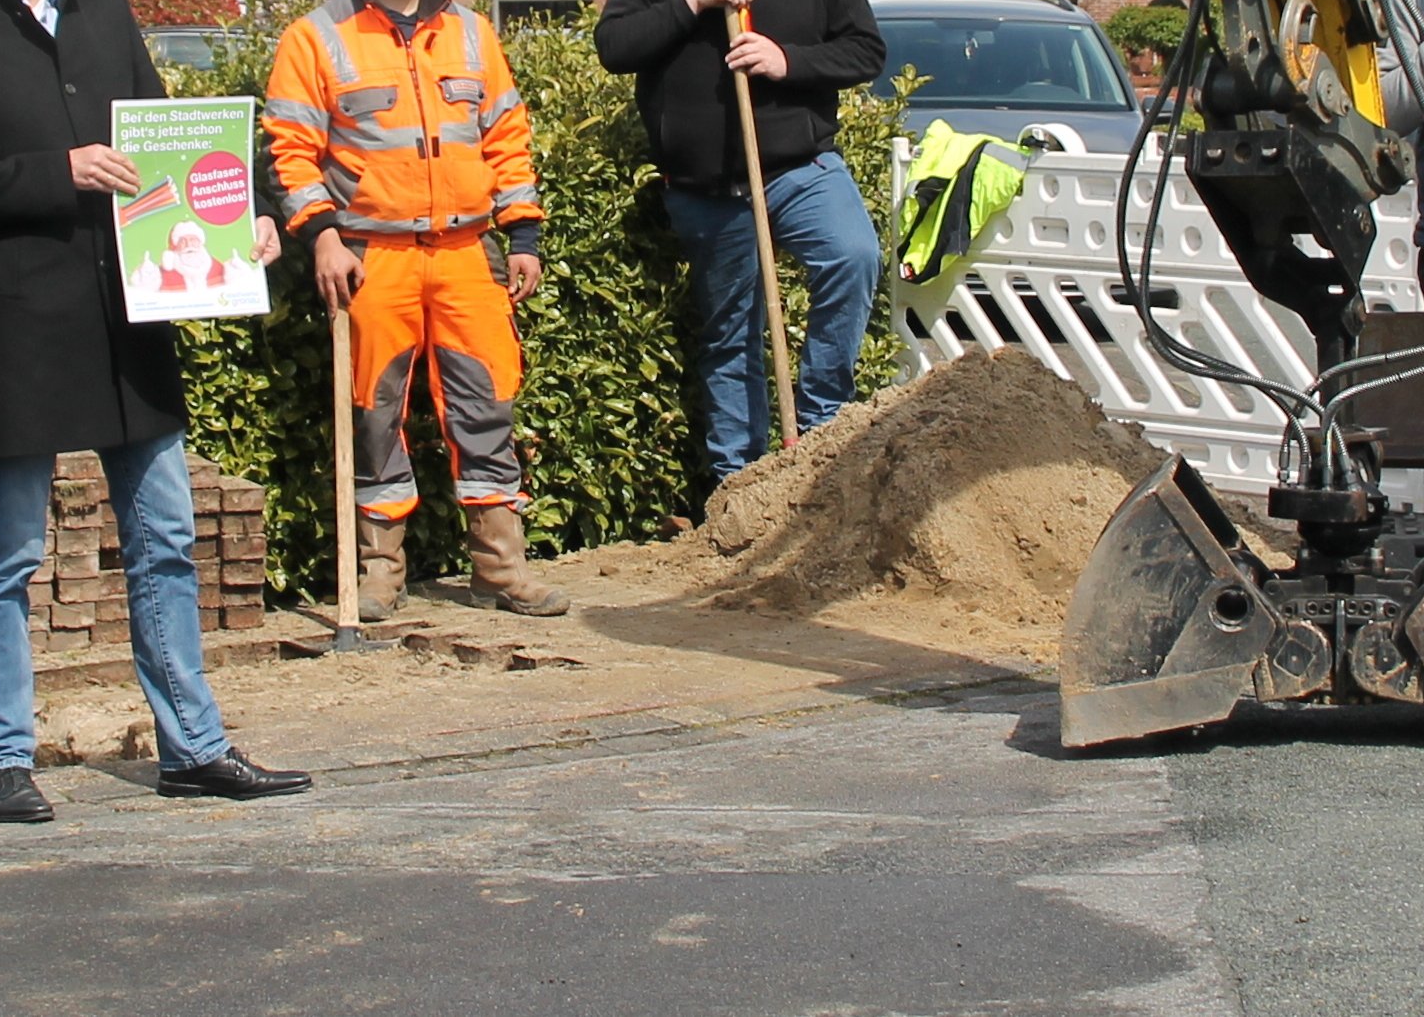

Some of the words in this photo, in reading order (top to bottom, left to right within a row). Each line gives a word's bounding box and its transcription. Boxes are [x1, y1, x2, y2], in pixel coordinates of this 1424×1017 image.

[121, 111, 142, 124] Bei
[145, 110, 167, 123] den
[169, 109, 244, 122] Stadtwerken
[157, 124, 184, 139] jetzt
[187, 124, 223, 136] schon
[120, 141, 140, 153] die
[143, 138, 212, 152] Geschenke:
[189, 167, 243, 184] Glasfaser-
[191, 179, 246, 197] Anschluss
[193, 191, 248, 210] kostenlos!
